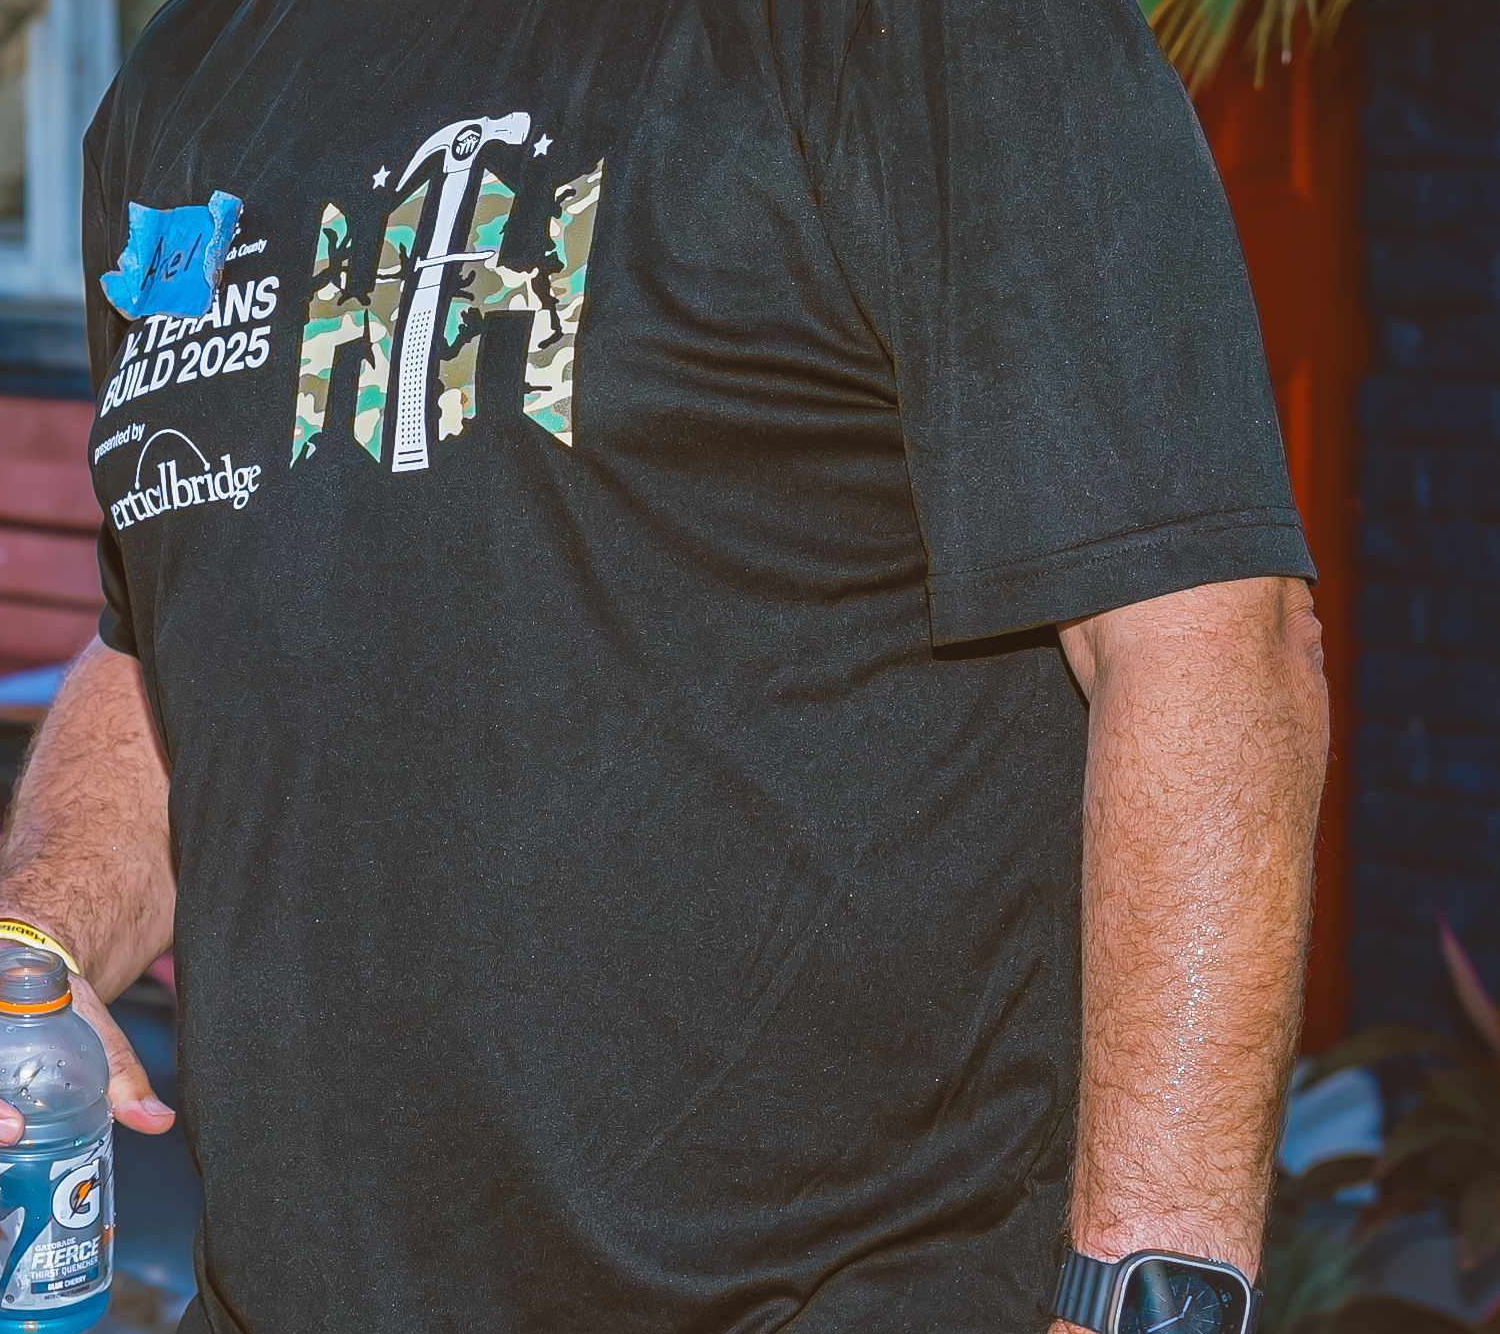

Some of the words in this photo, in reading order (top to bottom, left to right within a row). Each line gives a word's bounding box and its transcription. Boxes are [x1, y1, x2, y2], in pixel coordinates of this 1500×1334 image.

[238, 238, 268, 254] County
[100, 349, 176, 419] BUILD
[176, 325, 272, 384] 2025
[95, 424, 131, 465] presented
[131, 422, 146, 442] by
[31, 1234, 102, 1270] FIERCE
[35, 1237, 77, 1252] GATORADE
[30, 1267, 60, 1280] THIRST
[61, 1255, 99, 1277] QUENCHER
[47, 1280, 64, 1291] BLUE
